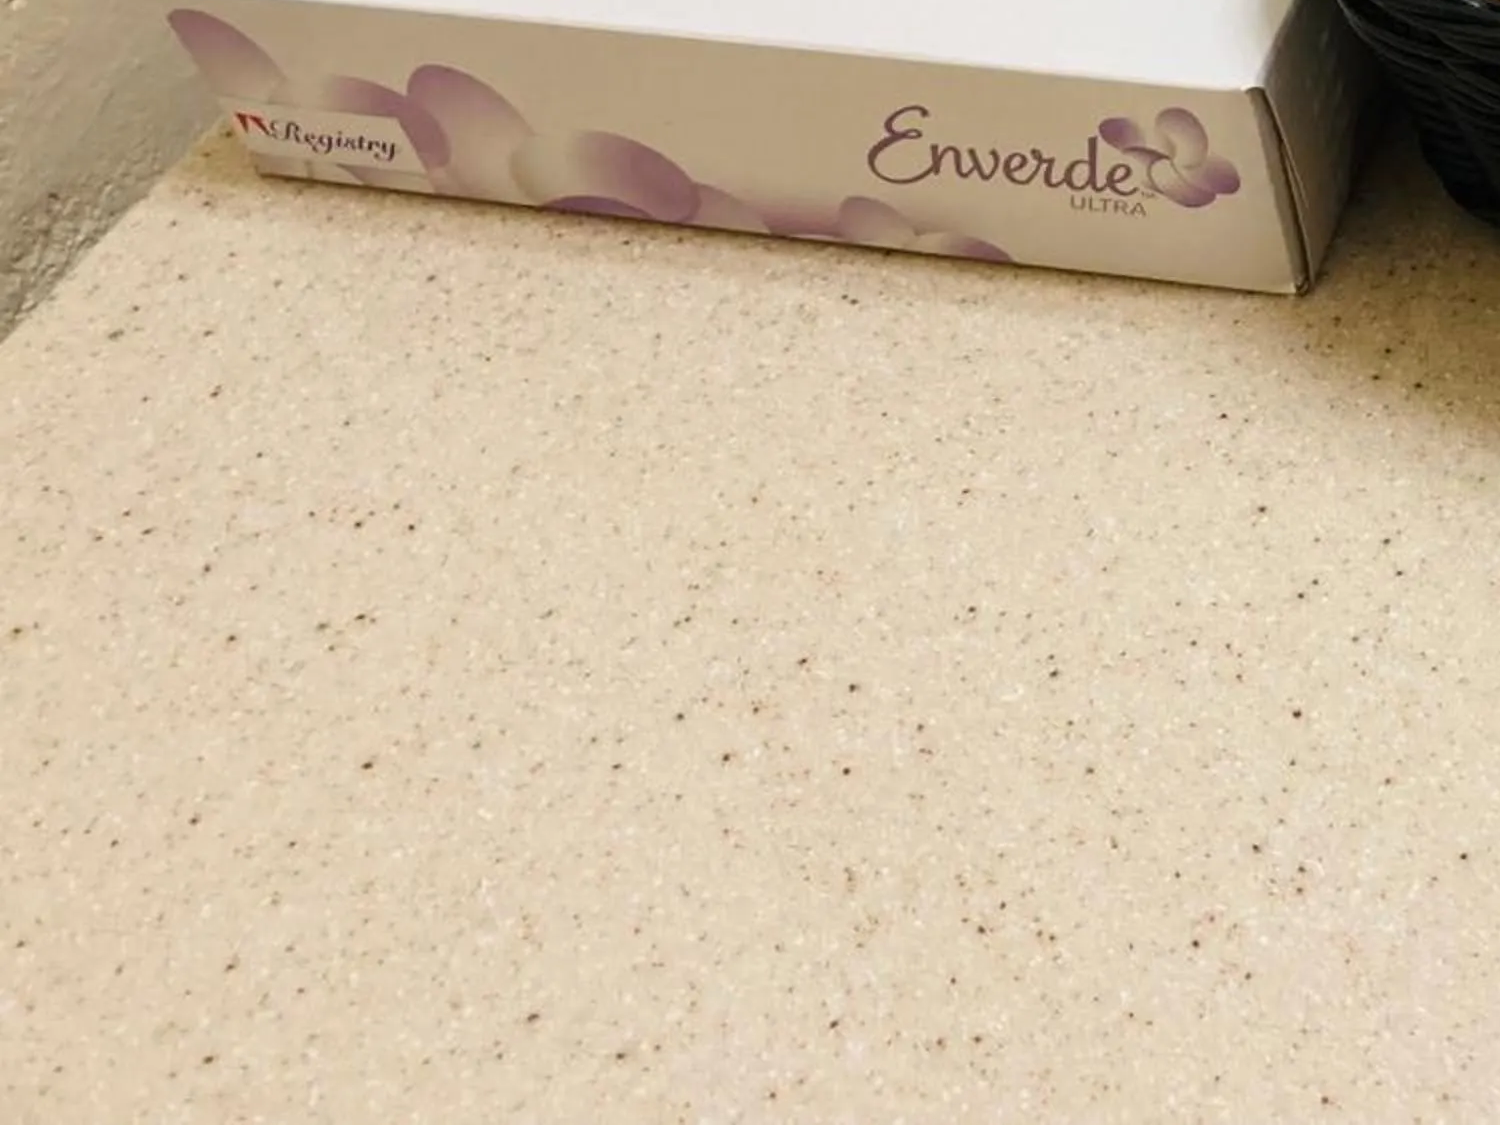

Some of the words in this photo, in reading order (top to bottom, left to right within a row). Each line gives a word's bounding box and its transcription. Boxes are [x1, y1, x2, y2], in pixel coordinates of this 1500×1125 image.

[269, 119, 397, 162] Registry
[867, 105, 1139, 196] Enverde
[1069, 194, 1148, 217] ULTRA
